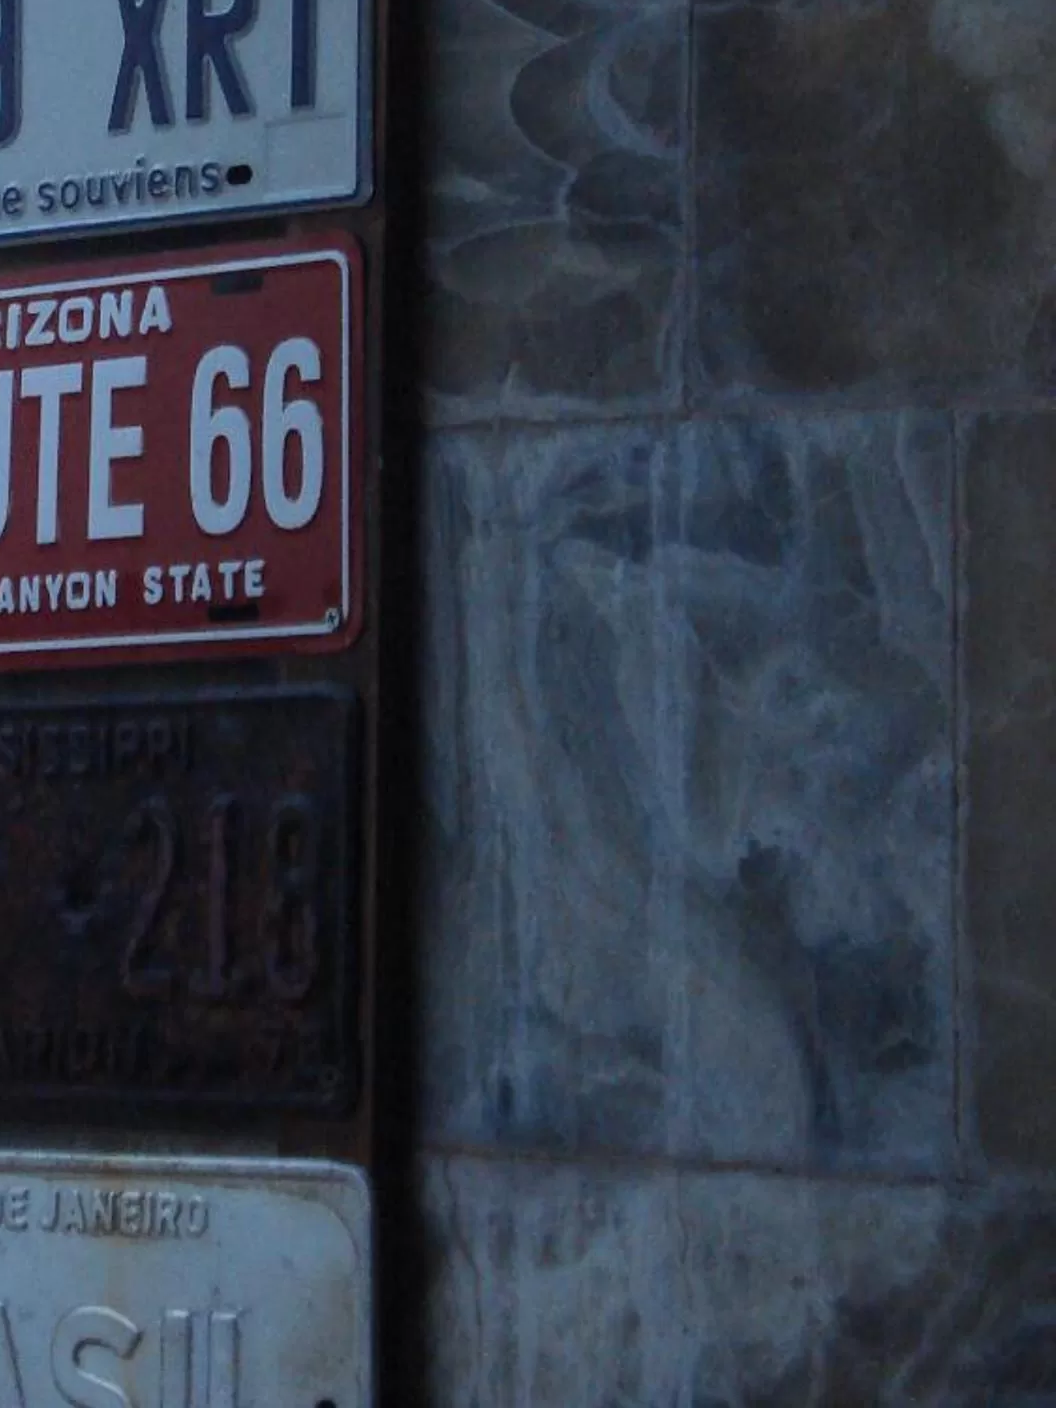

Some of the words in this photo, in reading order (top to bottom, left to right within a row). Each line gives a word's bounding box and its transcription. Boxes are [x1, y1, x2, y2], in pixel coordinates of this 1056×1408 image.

[36, 155, 223, 212] souviens
[189, 337, 325, 536] 66
[143, 558, 266, 606] STATE
[39, 1190, 210, 1240] JANEIRO
